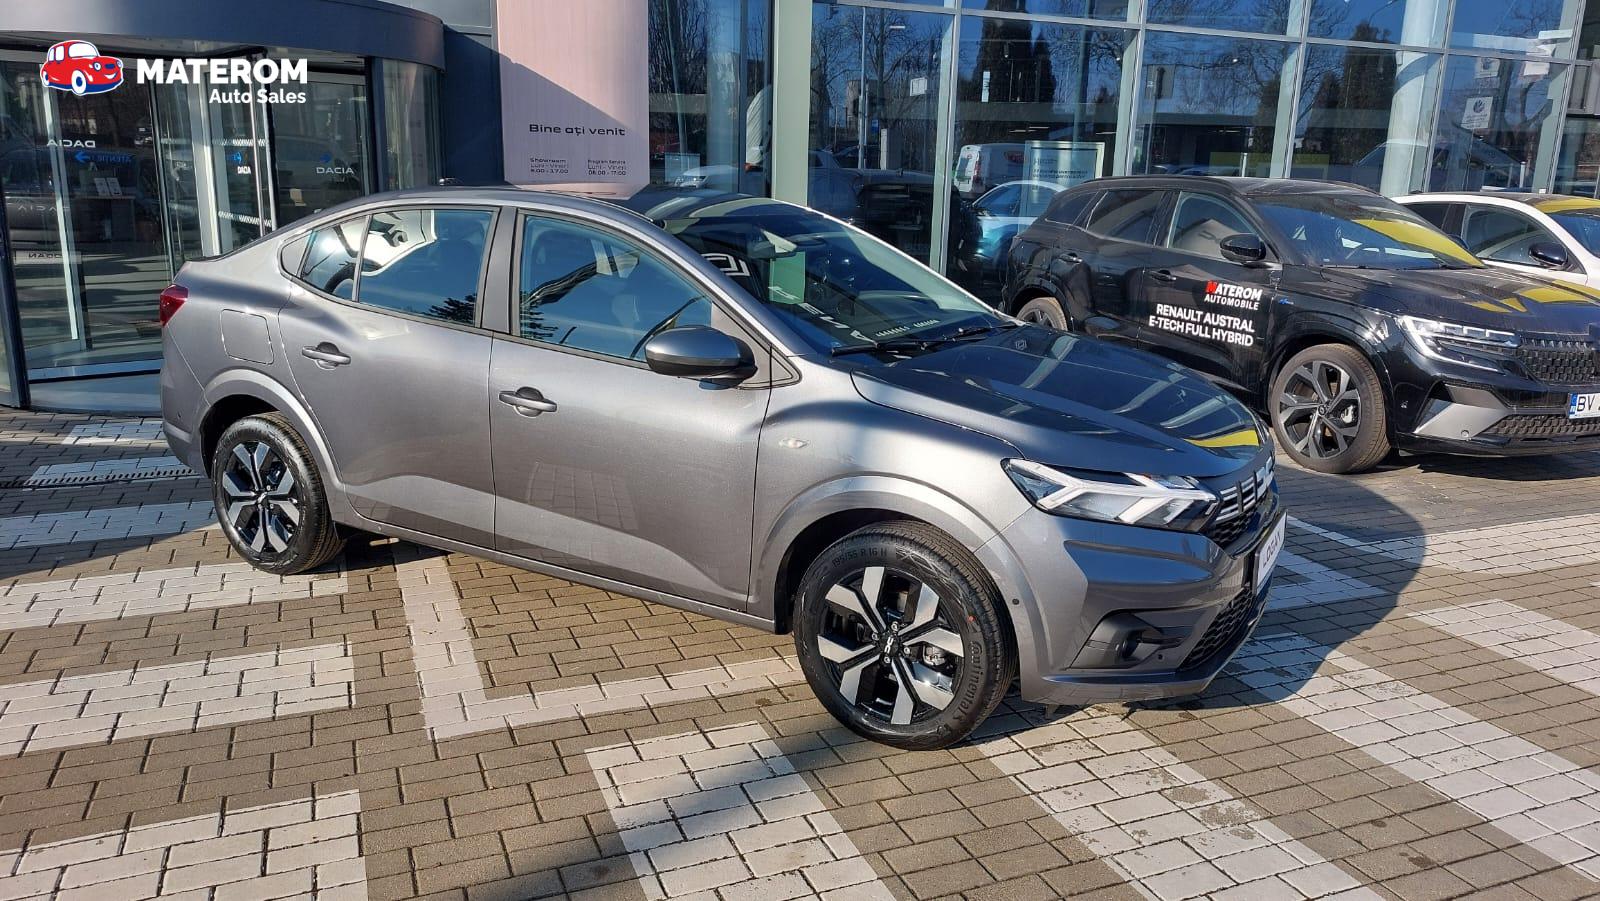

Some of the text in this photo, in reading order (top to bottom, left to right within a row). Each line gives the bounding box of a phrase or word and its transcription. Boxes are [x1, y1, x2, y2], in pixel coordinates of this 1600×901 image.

[529, 124, 562, 134] Bine
[588, 127, 626, 136] venit
[316, 167, 355, 175] DACIA
[1205, 280, 1263, 301] MATEROM
[1204, 294, 1260, 311] AUTOMOBILE
[1156, 303, 1255, 333] RENAULT AUSTRAL
[1148, 315, 1254, 347] E-TECH FULL HYBRID
[1577, 395, 1596, 412] BV
[868, 546, 878, 557] 16
[952, 640, 984, 721] Continental
